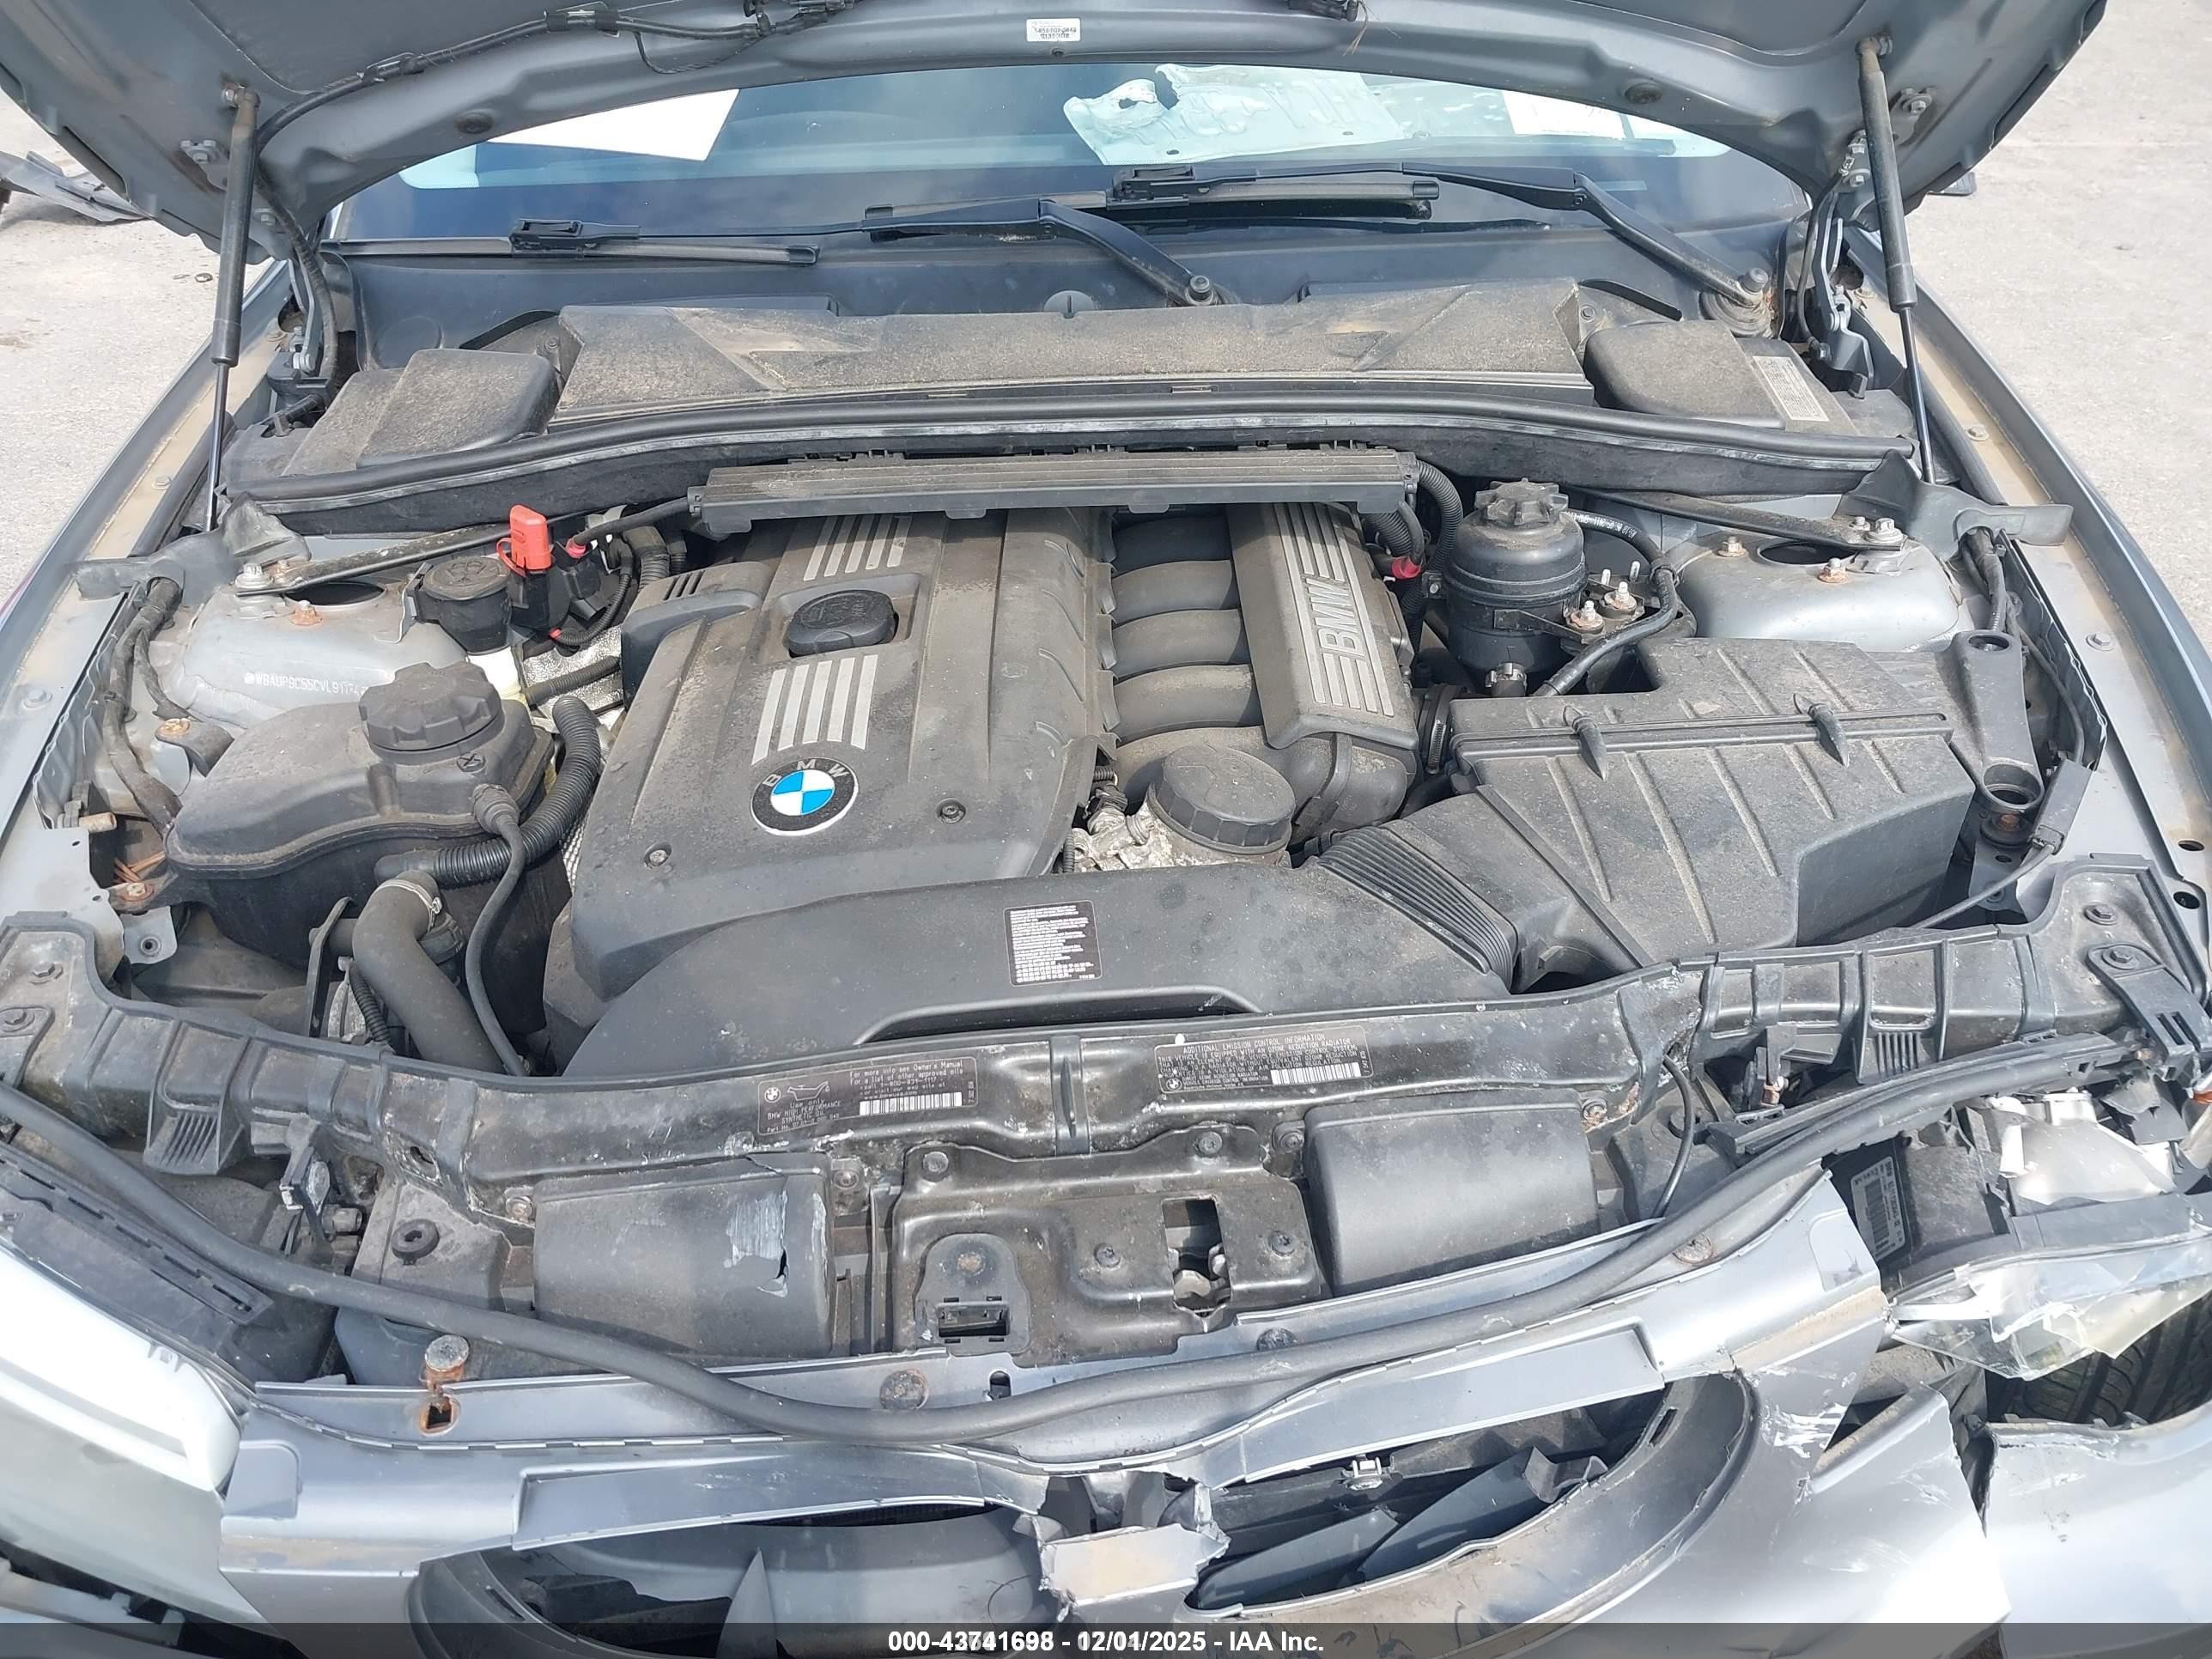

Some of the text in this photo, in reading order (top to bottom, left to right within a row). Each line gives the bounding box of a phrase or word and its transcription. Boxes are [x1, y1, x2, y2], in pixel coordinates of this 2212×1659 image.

[1306, 578, 1365, 657] BMW
[763, 759, 849, 787] BMW
[1183, 1033, 1325, 1054] ADDITIONAL EMISSION CONTROL INFORMATION
[914, 1062, 937, 1071] Owner's
[941, 1060, 963, 1068] Manual
[919, 1069, 946, 1079] approved
[808, 1097, 824, 1107] only
[768, 1111, 781, 1120] BMW
